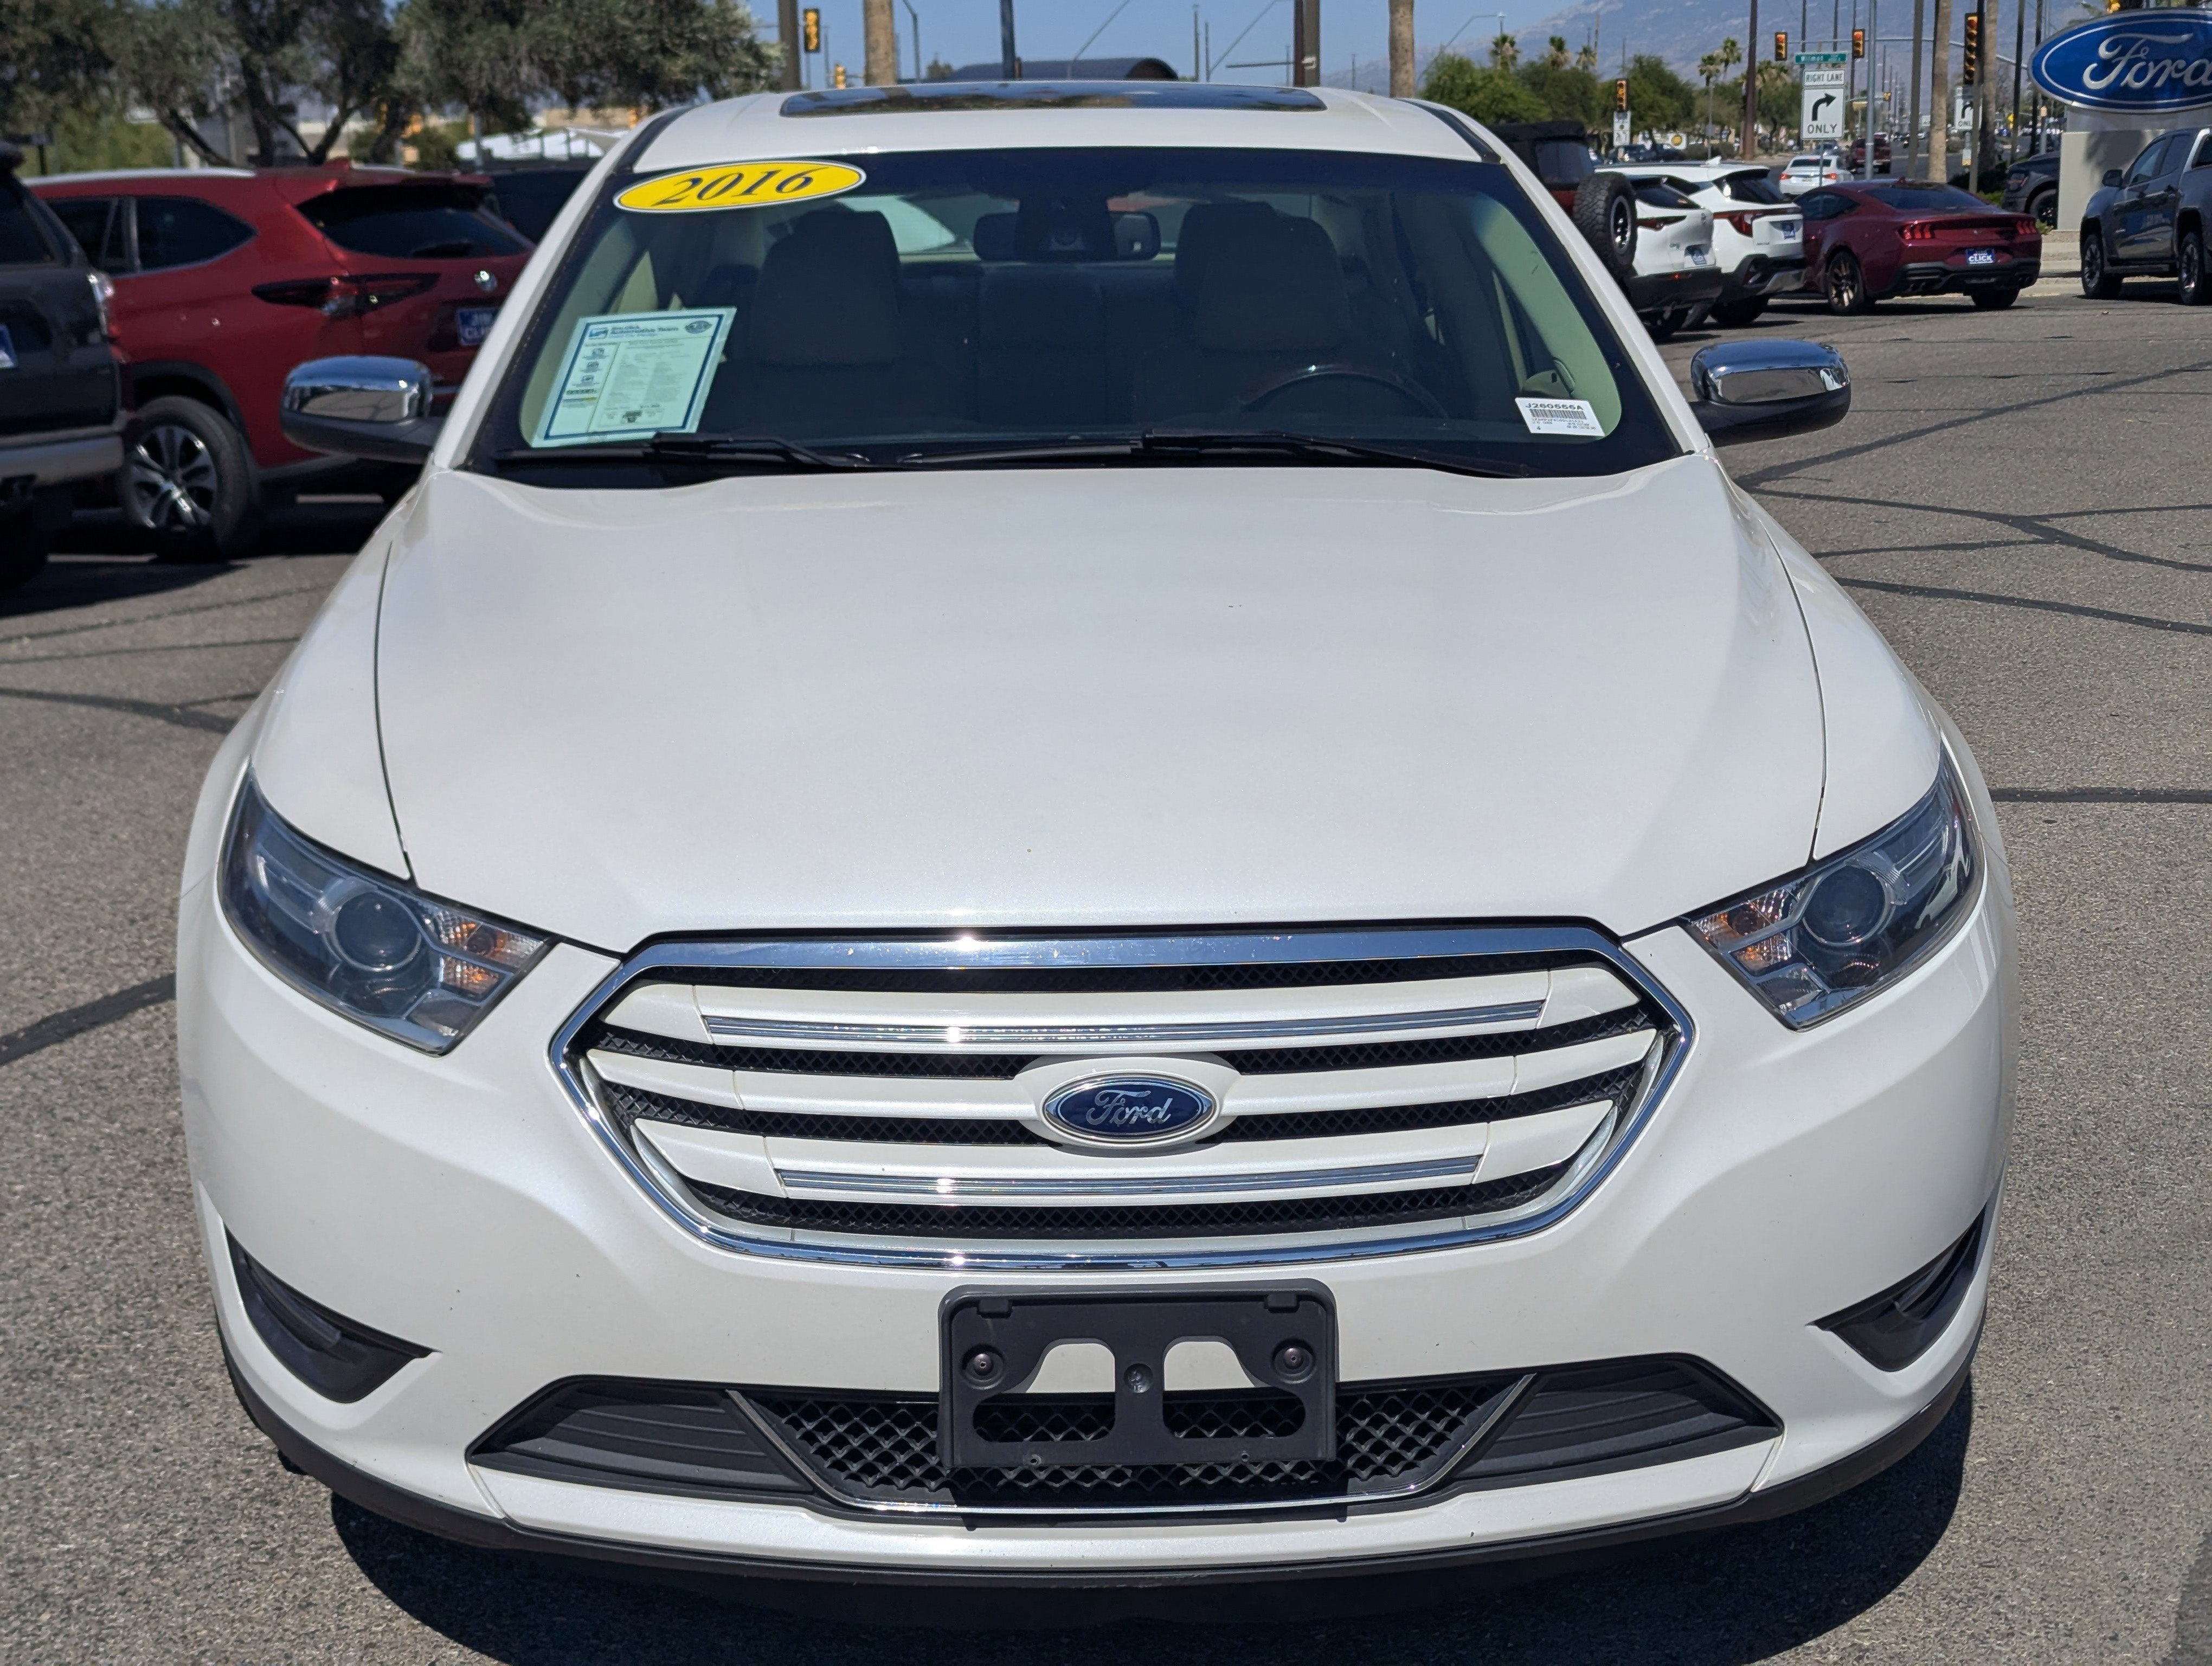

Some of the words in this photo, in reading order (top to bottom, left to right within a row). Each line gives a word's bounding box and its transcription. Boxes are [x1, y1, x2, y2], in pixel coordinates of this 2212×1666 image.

[1805, 74, 1825, 82] RIGHT
[1827, 73, 1843, 82] LANE
[1807, 123, 1837, 134] ONLY
[651, 166, 830, 207] 2016
[1086, 1090, 1173, 1126] Ford
